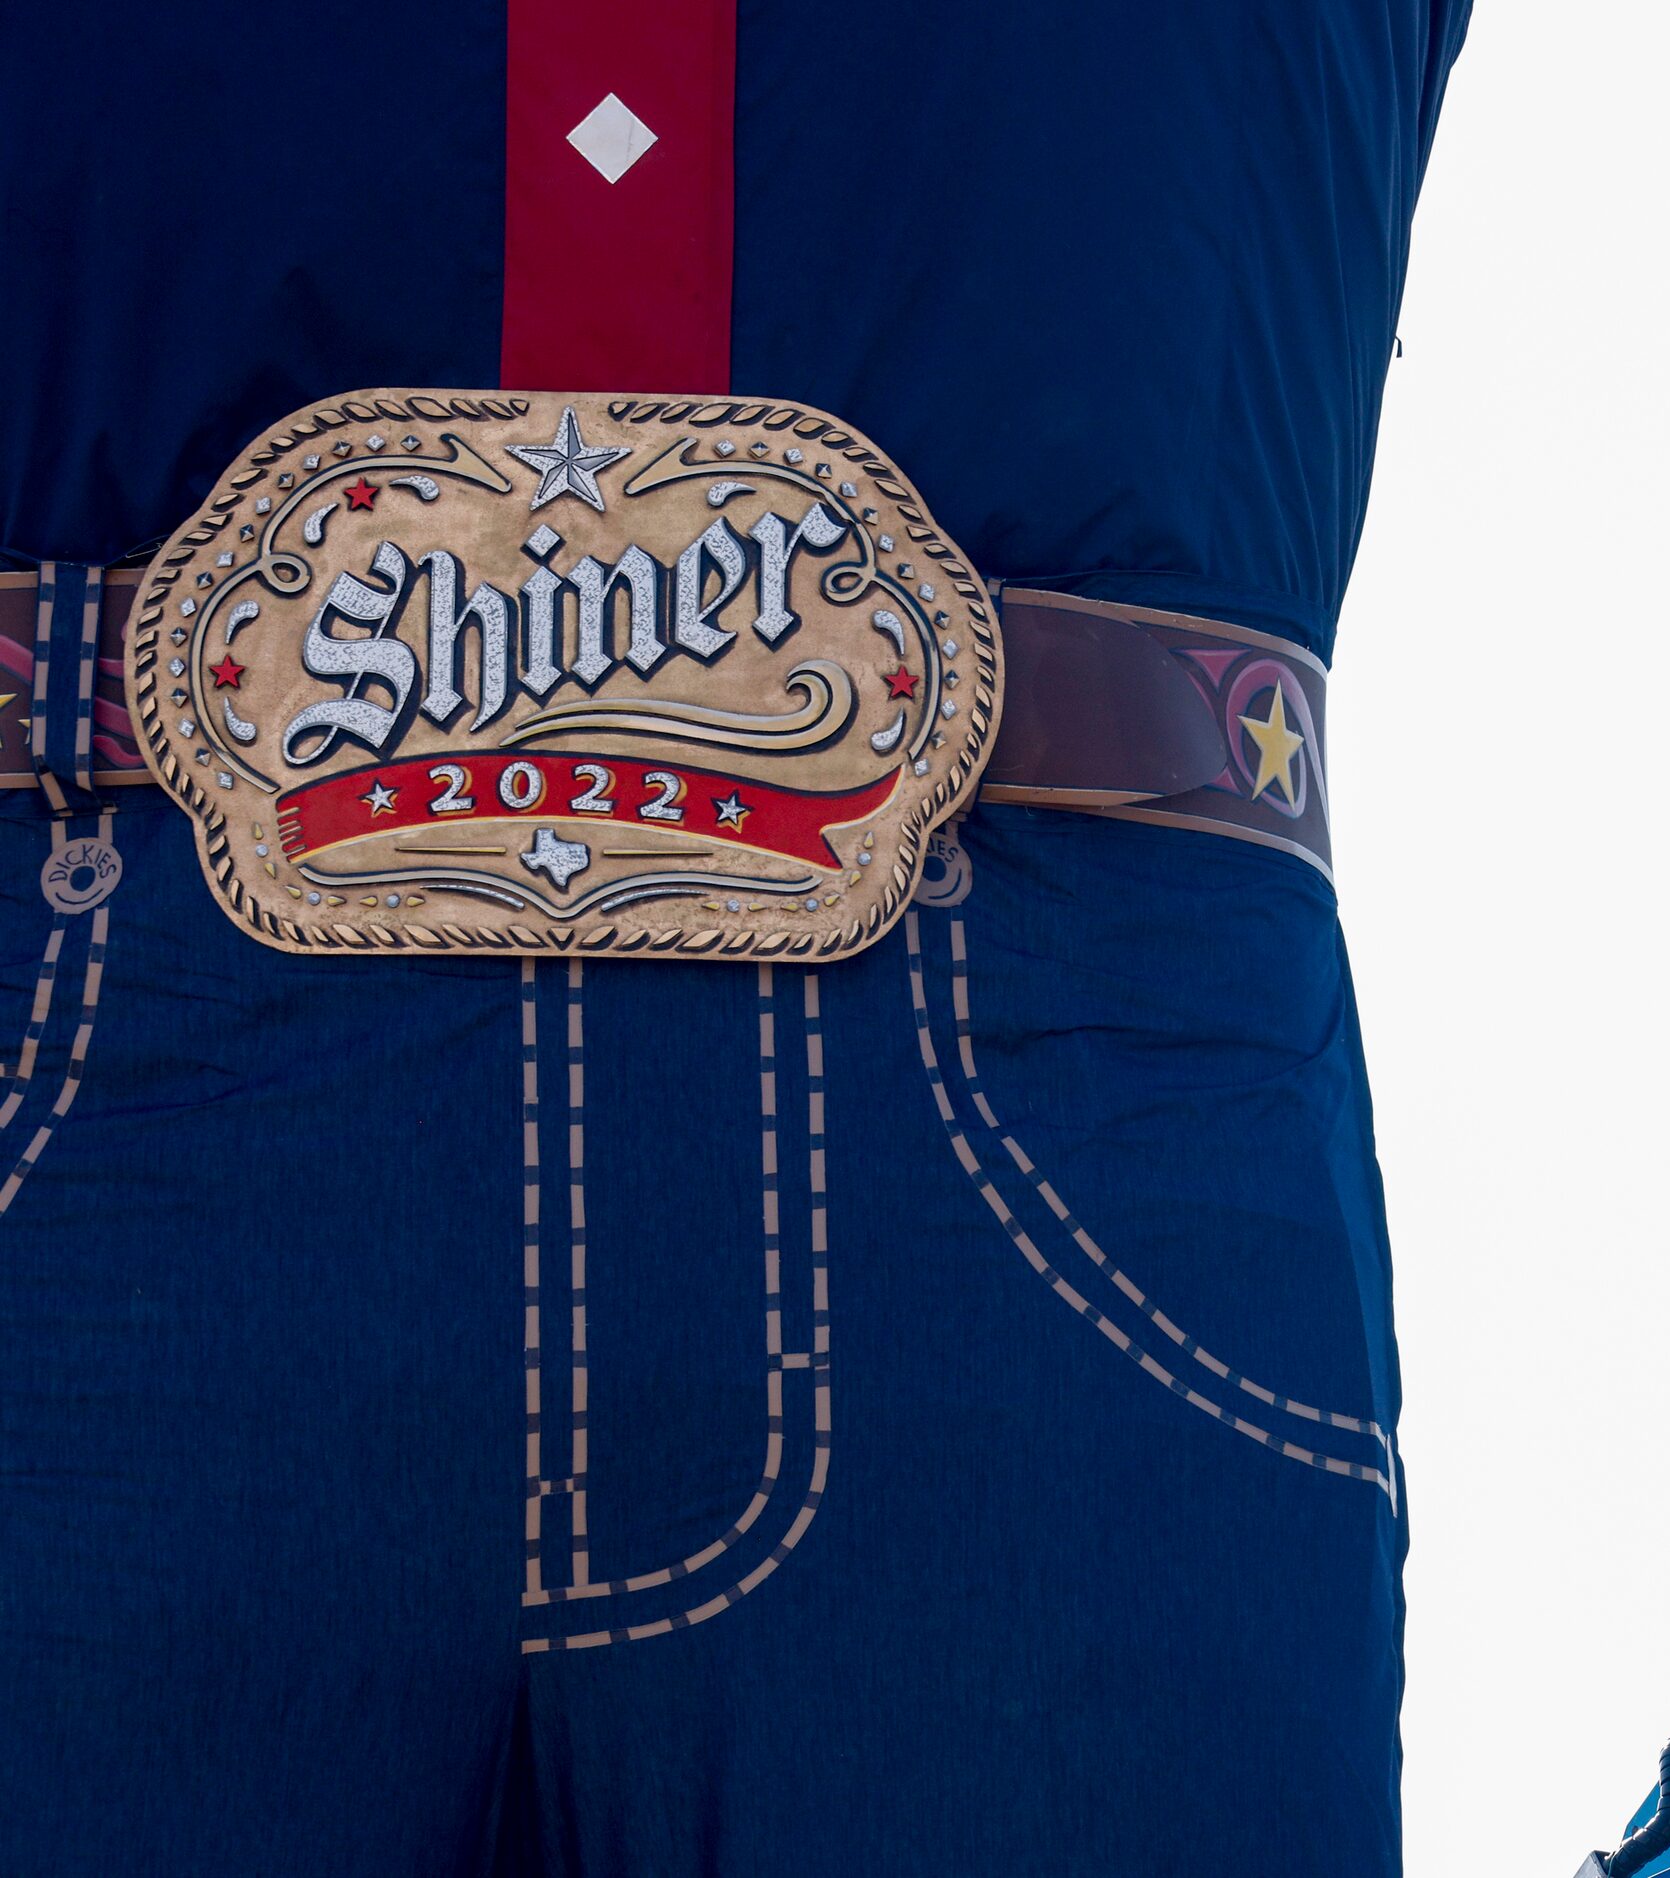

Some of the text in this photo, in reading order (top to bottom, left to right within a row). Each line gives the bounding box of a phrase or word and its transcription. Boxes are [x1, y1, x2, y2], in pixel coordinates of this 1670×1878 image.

[281, 502, 848, 765] Shiner
[427, 762, 686, 822] 2022
[48, 844, 117, 883] DICKIES
[926, 837, 959, 863] IES
